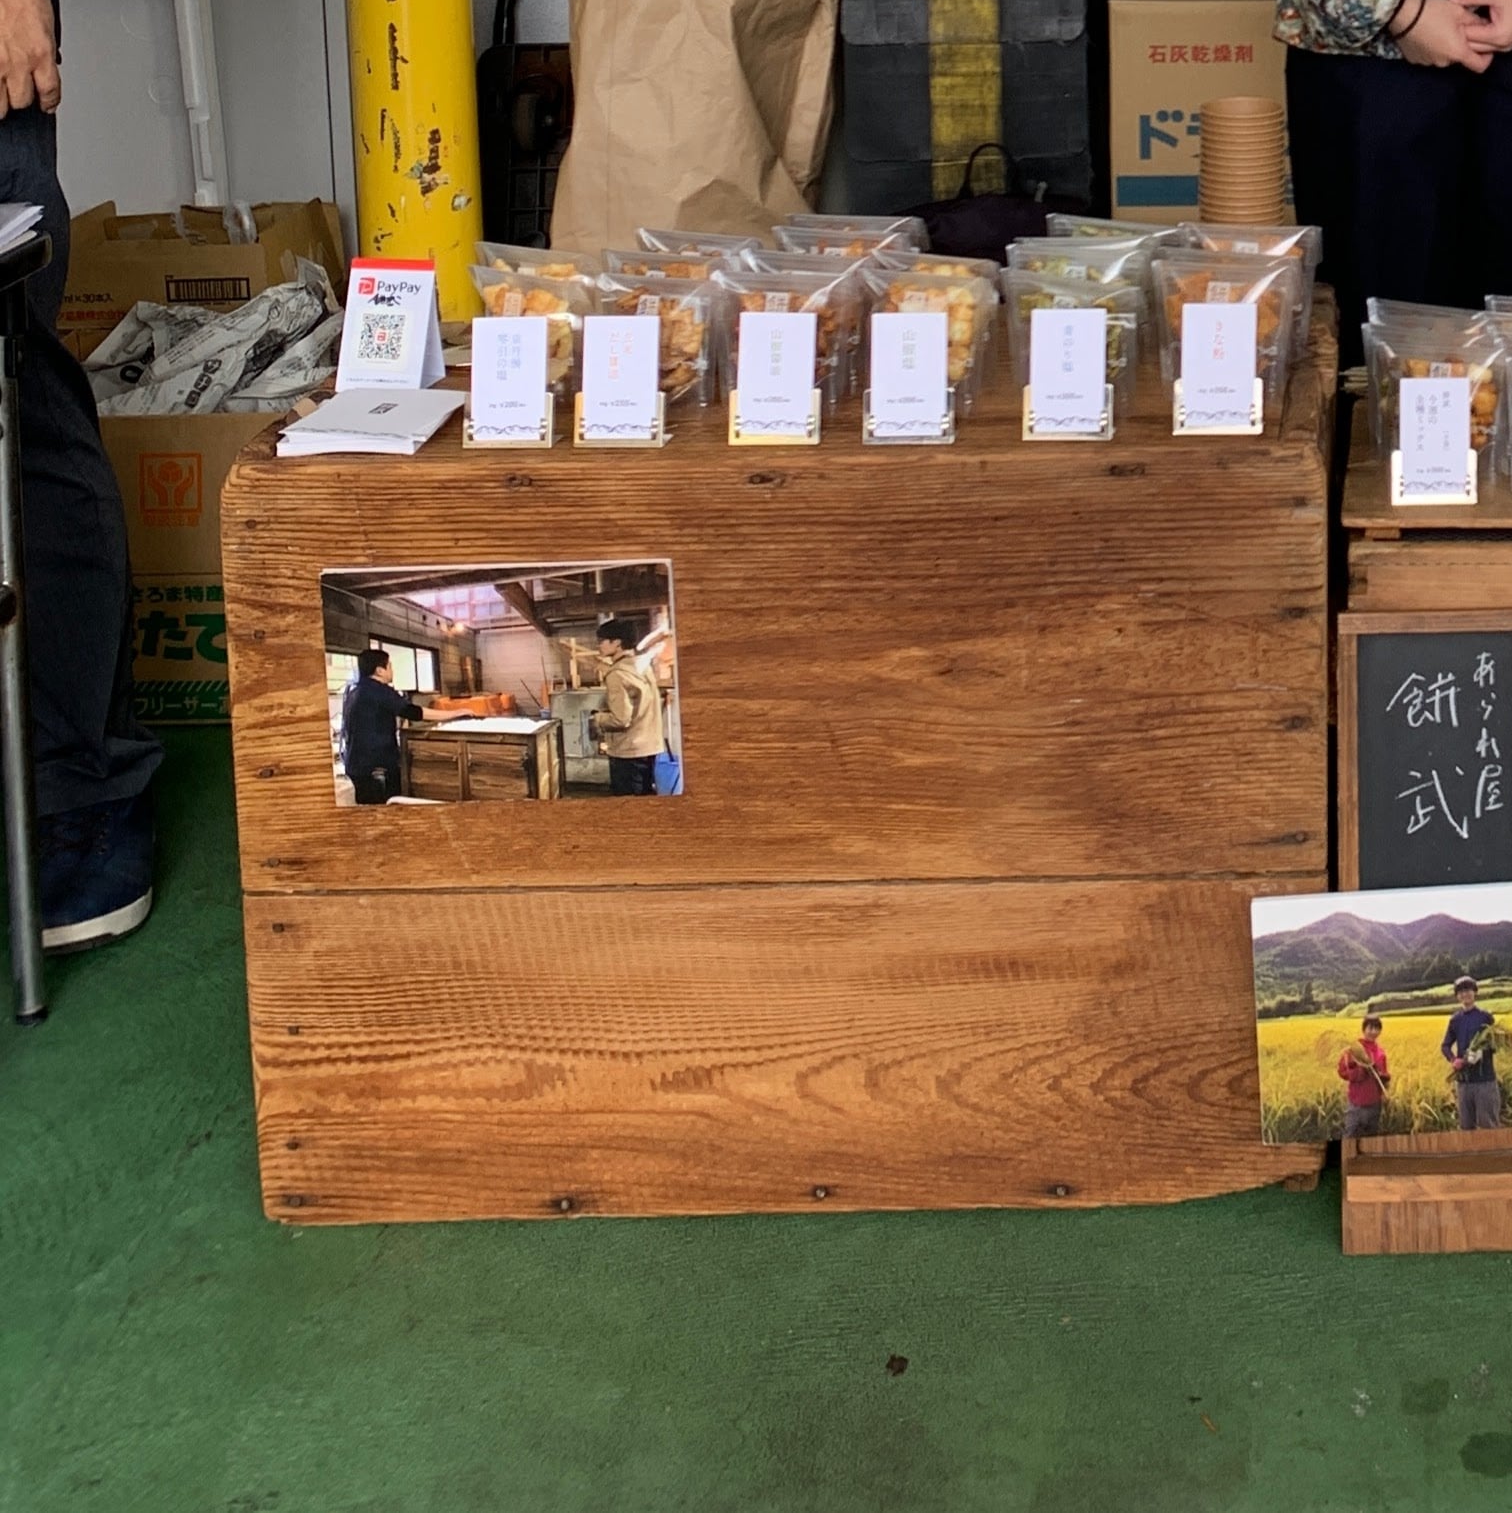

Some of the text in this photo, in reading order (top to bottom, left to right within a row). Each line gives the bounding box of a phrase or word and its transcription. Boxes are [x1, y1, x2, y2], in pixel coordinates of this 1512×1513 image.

[1148, 44, 1254, 64] 石灰乾燥剤
[377, 280, 421, 296] PayPay
[137, 610, 227, 664] たて
[1385, 671, 1469, 839] 餅武
[1473, 651, 1503, 819] あられ屋
